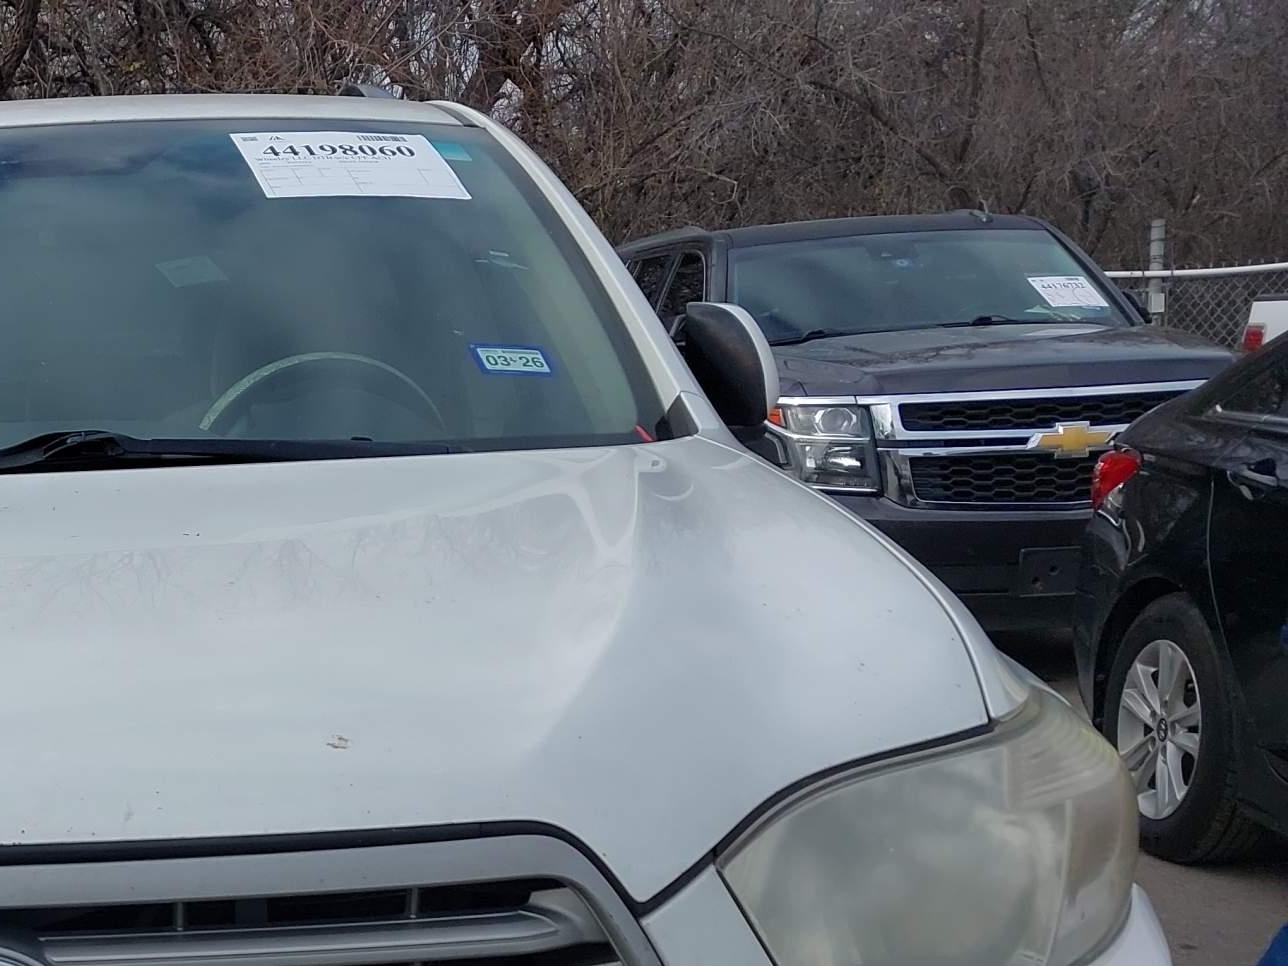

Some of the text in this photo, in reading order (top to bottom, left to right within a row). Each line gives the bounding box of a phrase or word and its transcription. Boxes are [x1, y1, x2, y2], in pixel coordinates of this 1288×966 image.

[263, 143, 416, 158] 44198060
[485, 354, 545, 369] 03 26
